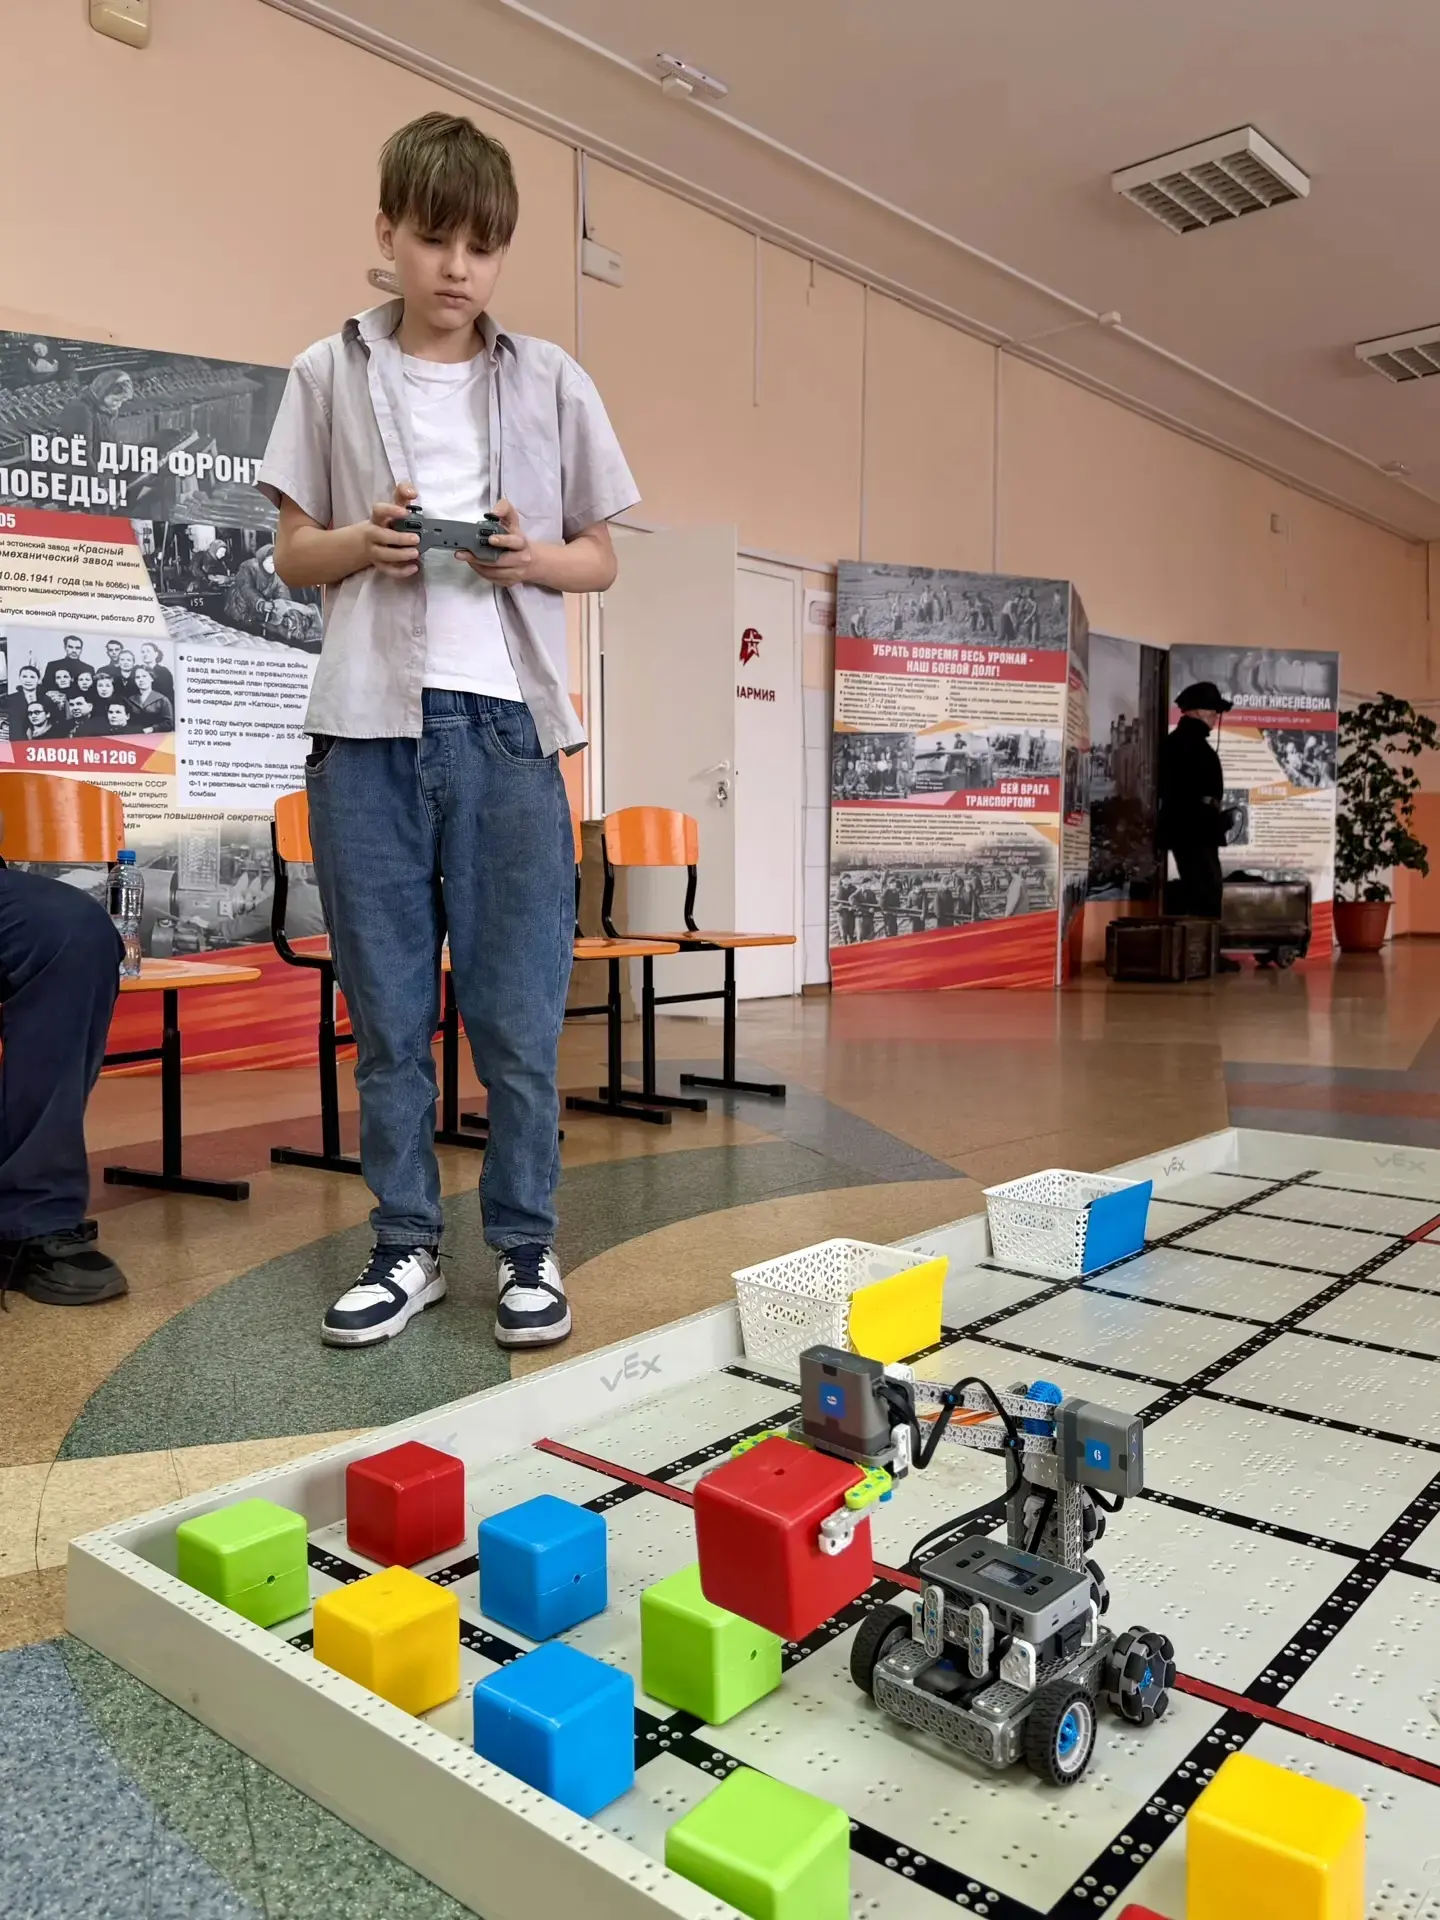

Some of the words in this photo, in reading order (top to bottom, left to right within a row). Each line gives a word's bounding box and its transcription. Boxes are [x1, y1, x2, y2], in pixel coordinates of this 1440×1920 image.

[31, 434, 87, 467] ВСЁ
[97, 441, 158, 475] ДЛЯ
[6, 540, 46, 550] эстонский
[47, 543, 71, 552] завод
[72, 543, 124, 556] «Красный
[0, 550, 80, 563] механический
[82, 556, 114, 567] завод
[57, 577, 81, 586] года
[82, 579, 93, 587] (за
[95, 579, 104, 587] №
[28, 588, 90, 597] машиностроения
[97, 592, 154, 602] эвакуированных
[190, 597, 204, 607] 155
[58, 612, 100, 621] продукции,
[101, 614, 135, 623] работало
[137, 615, 155, 624] 870
[872, 643, 909, 658] УБРАТЬ
[912, 646, 959, 661] ВОВРЕМЯ
[961, 649, 985, 662] ВЕСЬ
[988, 651, 1027, 665] УРОЖАЙ
[256, 671, 308, 679] перевыполнял
[906, 660, 930, 673] НАШ
[931, 661, 969, 675] БОЕВОЙ
[971, 664, 1001, 678] ДОЛГ!
[187, 677, 245, 686] государственный
[264, 681, 308, 690] производства
[187, 687, 232, 696] боеприпасов,
[203, 699, 232, 707] снаряды
[1233, 693, 1269, 707] ФРОНТ
[212, 720, 227, 728] году
[26, 747, 79, 765] ЗАВОД
[83, 748, 137, 765] №1206
[231, 761, 262, 770] профиль
[145, 780, 167, 788] СССР
[1000, 782, 1019, 794] БЕЙ
[1020, 783, 1050, 795] ВРАГА
[965, 795, 1036, 808] ТРАНСПОРТОМ!
[163, 812, 224, 821] повышенной
[1163, 1156, 1185, 1177] VEX
[1373, 1152, 1426, 1174] VEX
[600, 1352, 661, 1392] VEX
[1093, 1449, 1102, 1461] 6
